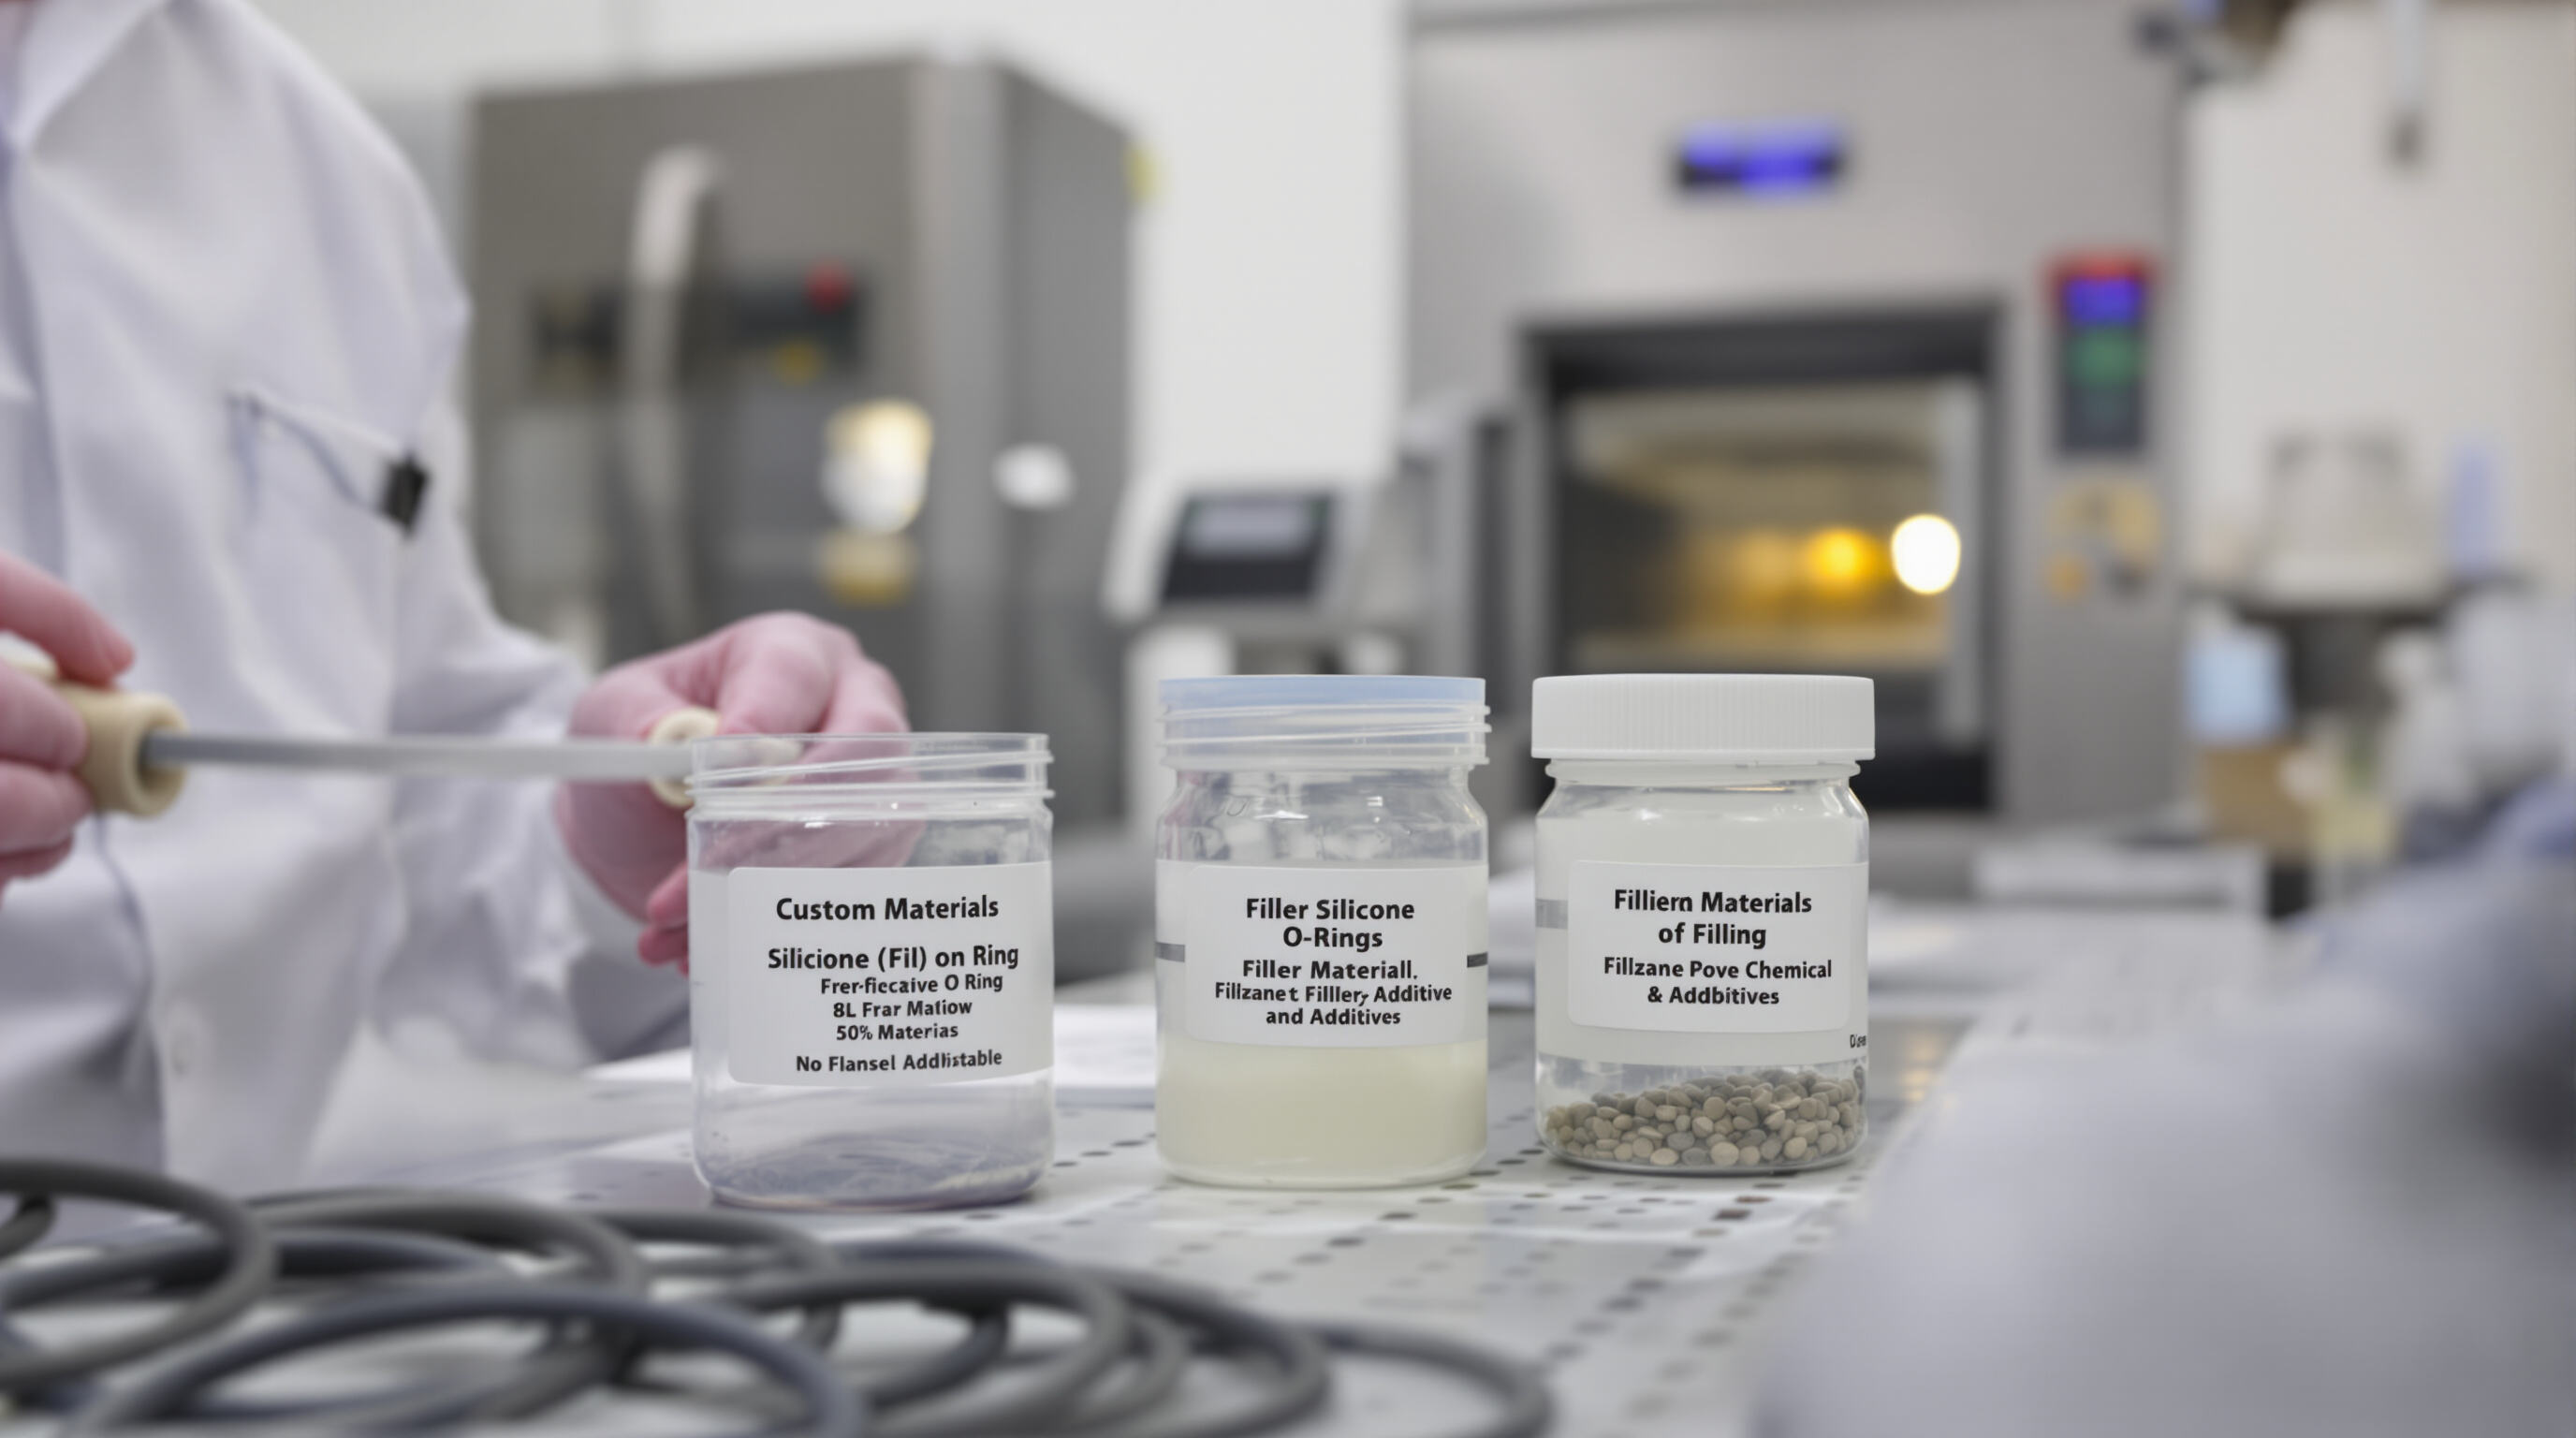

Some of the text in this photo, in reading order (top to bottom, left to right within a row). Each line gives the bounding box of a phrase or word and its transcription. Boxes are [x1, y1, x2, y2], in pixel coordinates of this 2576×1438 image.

[776, 894, 999, 921] Custom Materials
[1246, 897, 1415, 920] Filler Silicone
[1701, 890, 1812, 914] Materials
[1282, 926, 1383, 953] O-Rings
[1658, 921, 1767, 950] of Filling
[768, 944, 1019, 973] Silicione (Fil) on Ring
[1603, 956, 1832, 979] Fillzane Pove Chemical
[1242, 959, 1302, 979] Filler
[944, 974, 959, 991] O
[965, 973, 1003, 993] Ring
[1373, 984, 1453, 1004] Additive
[1647, 985, 1779, 1005] & Addbitives
[833, 1002, 856, 1019] 8L
[862, 1002, 902, 1018] Frar
[1266, 1007, 1401, 1026] and Additives
[836, 1022, 959, 1041] 50% Materias
[796, 1055, 823, 1072] No
[828, 1054, 896, 1072] Flansel
